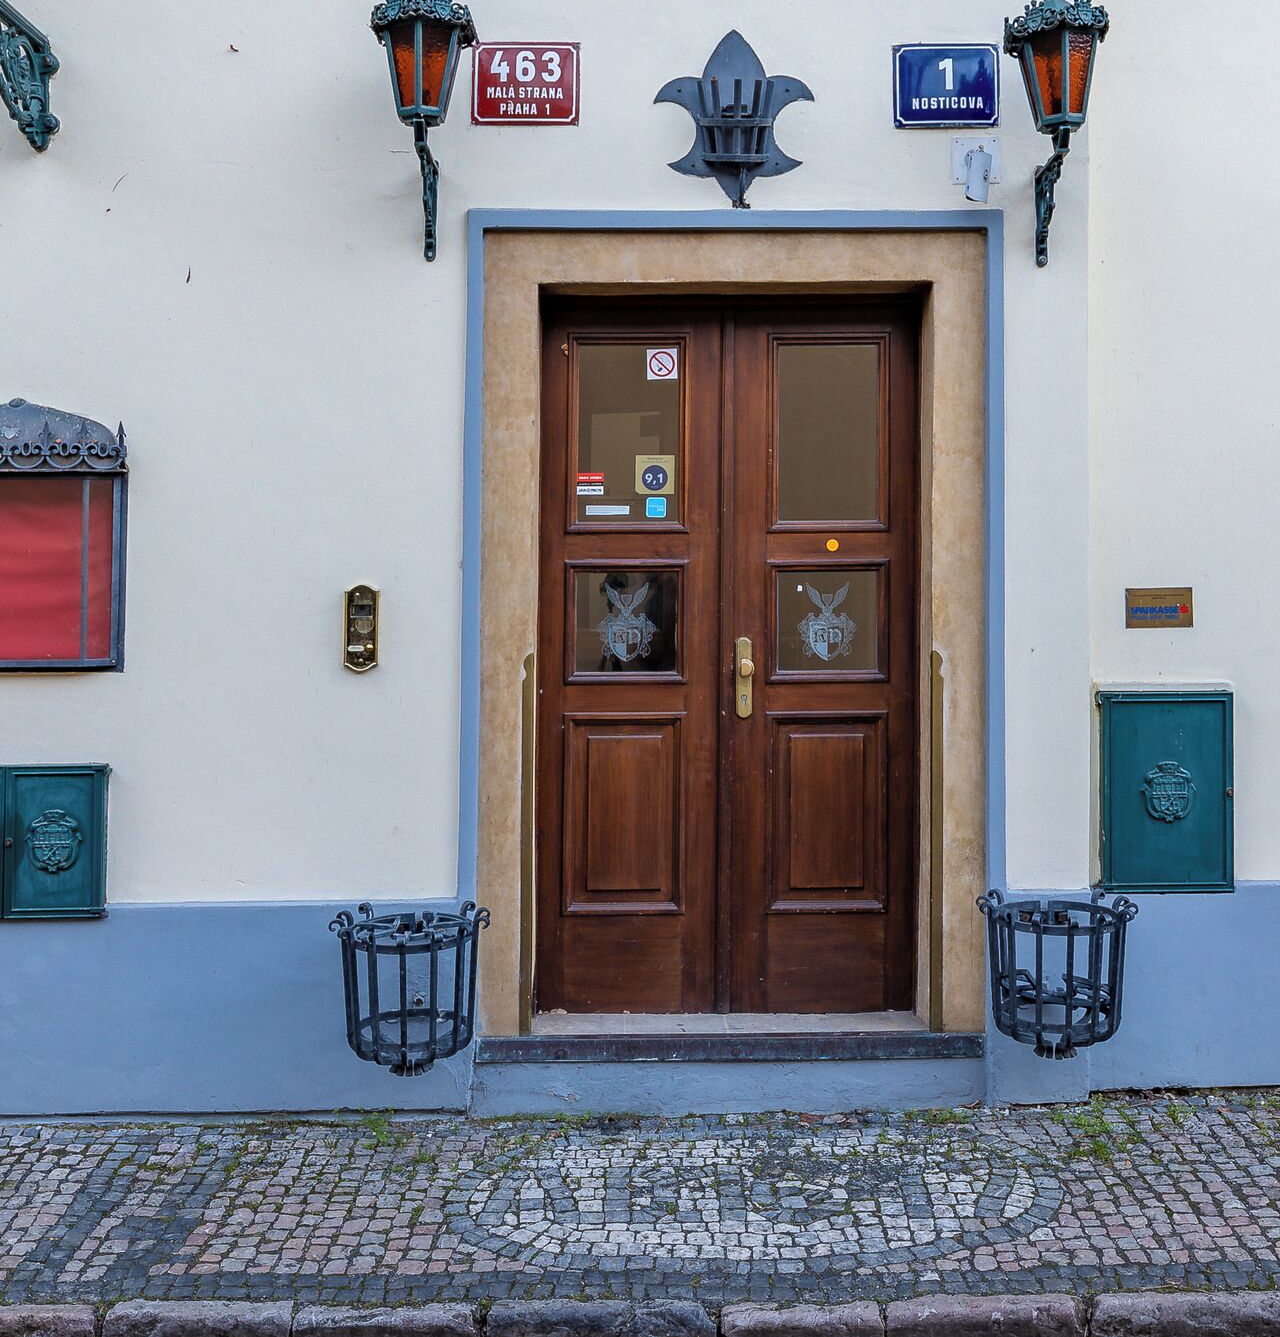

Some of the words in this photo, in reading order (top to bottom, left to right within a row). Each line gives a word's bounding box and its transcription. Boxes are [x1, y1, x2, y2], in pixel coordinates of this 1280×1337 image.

[490, 50, 562, 83] 463
[938, 57, 954, 91] 1
[486, 84, 516, 99] MALÁ
[518, 87, 564, 100] STRANA
[499, 102, 538, 116] PRAHA
[545, 103, 552, 116] 1
[911, 96, 985, 110] NOSTICOVA
[644, 473, 664, 485] 9,1
